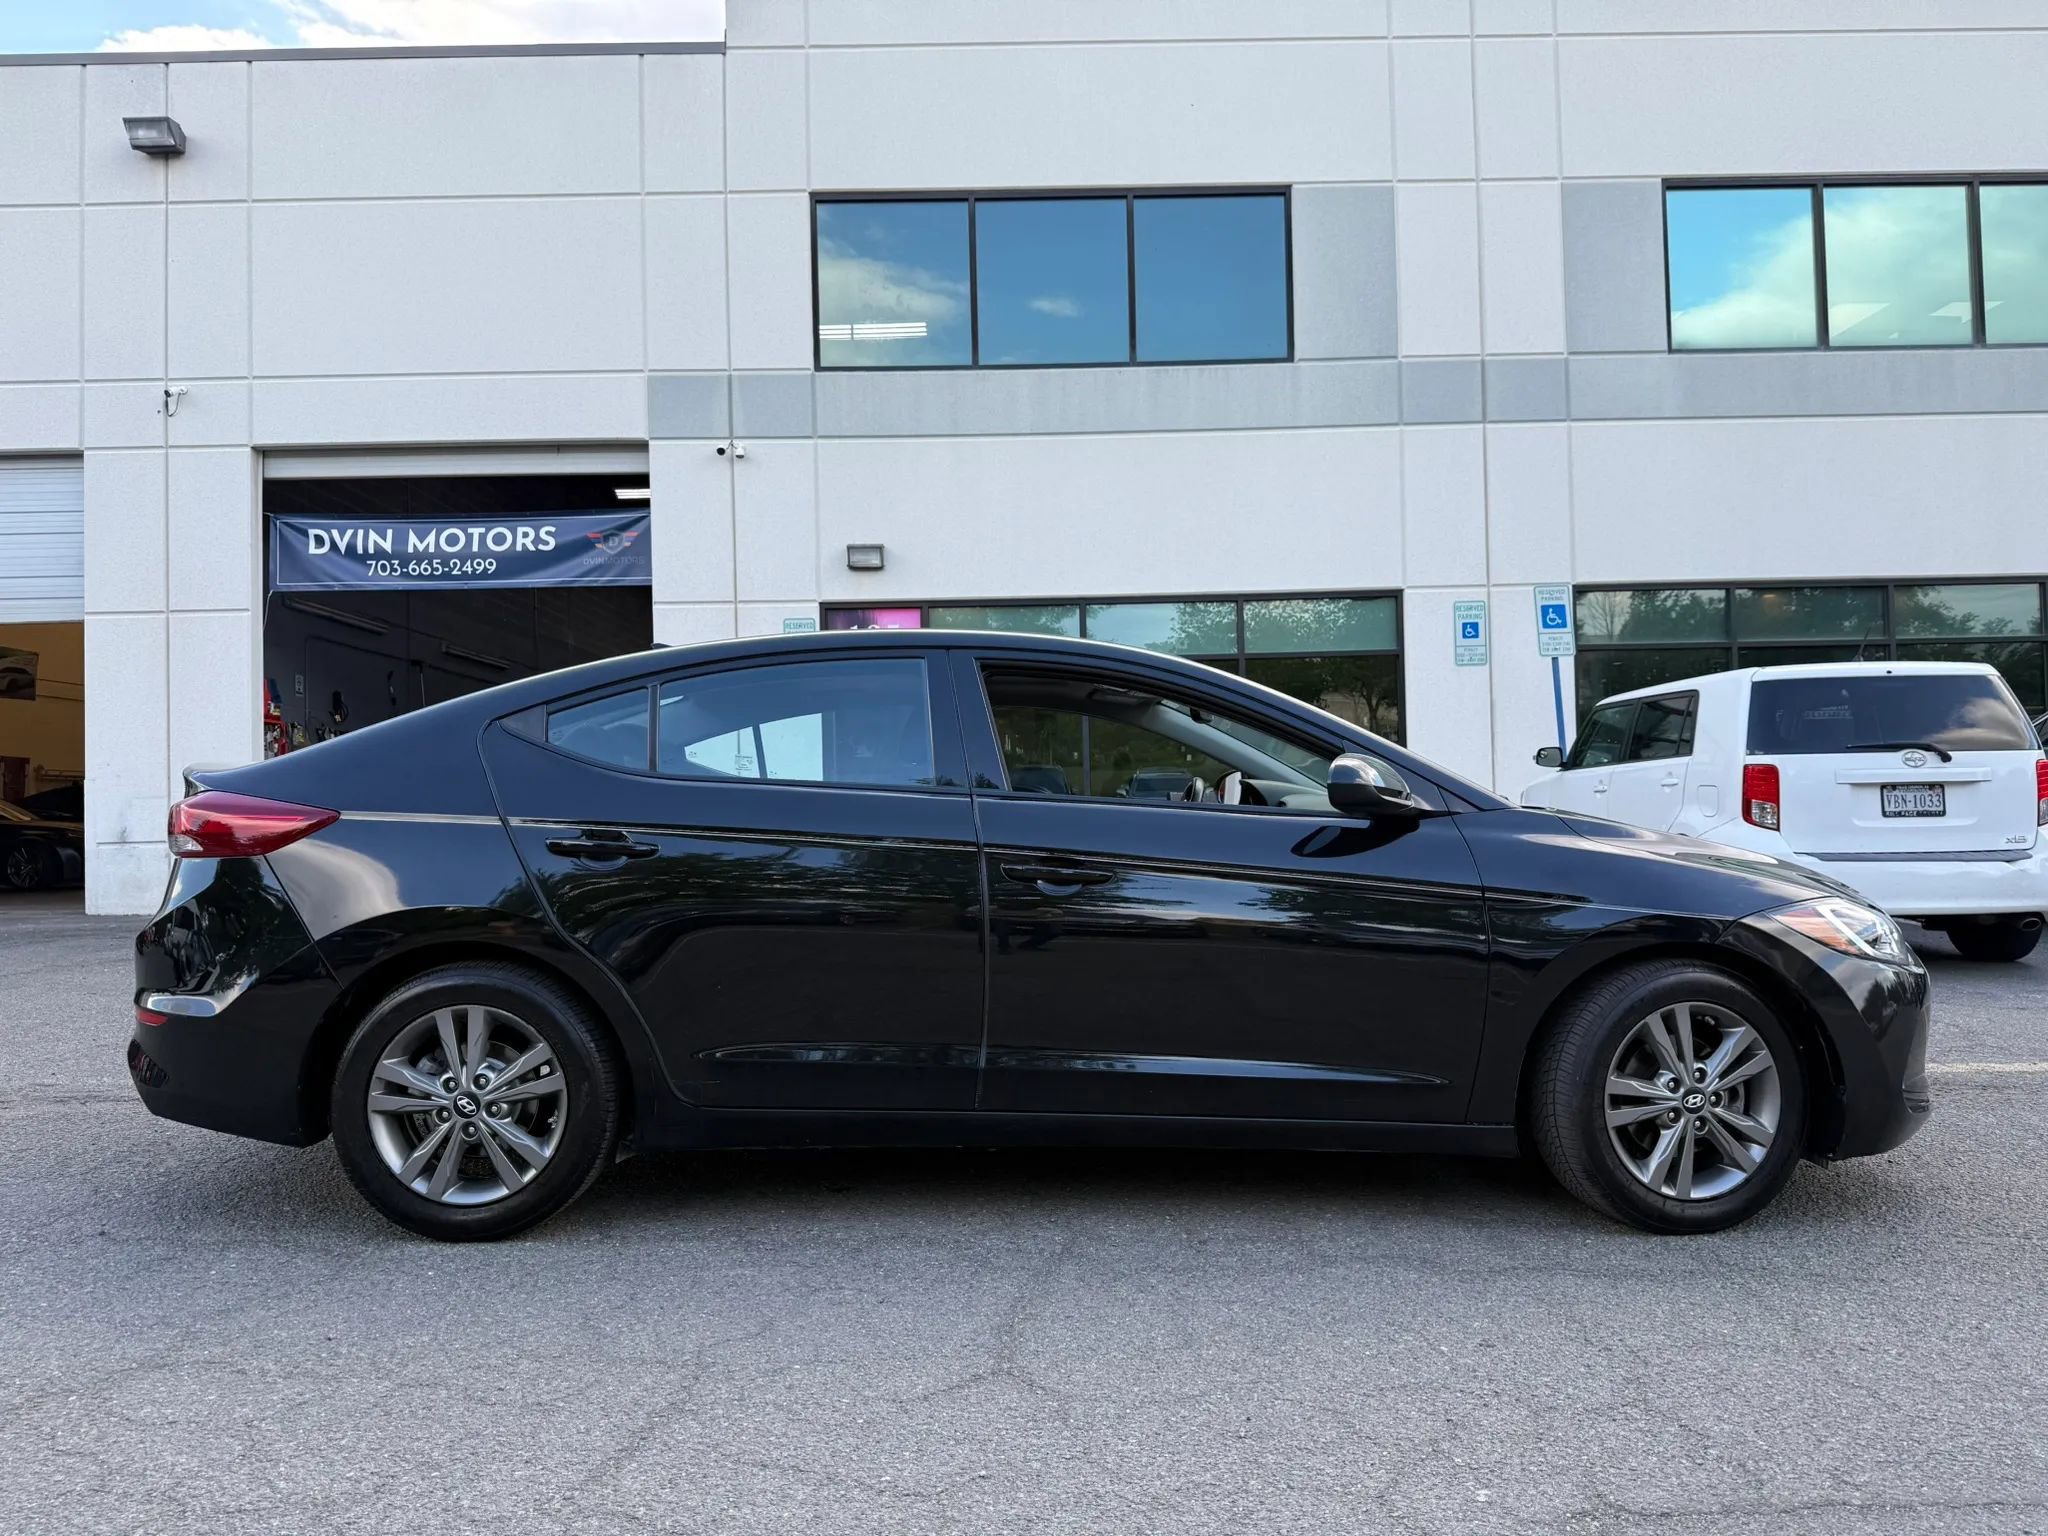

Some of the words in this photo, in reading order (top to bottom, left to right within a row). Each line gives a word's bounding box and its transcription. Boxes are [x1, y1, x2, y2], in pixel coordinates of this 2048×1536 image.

[307, 528, 393, 555] DVIN
[407, 526, 557, 553] MOTORS
[366, 558, 497, 577] 703-665-2499
[1886, 794, 1942, 809] VBN-1033
